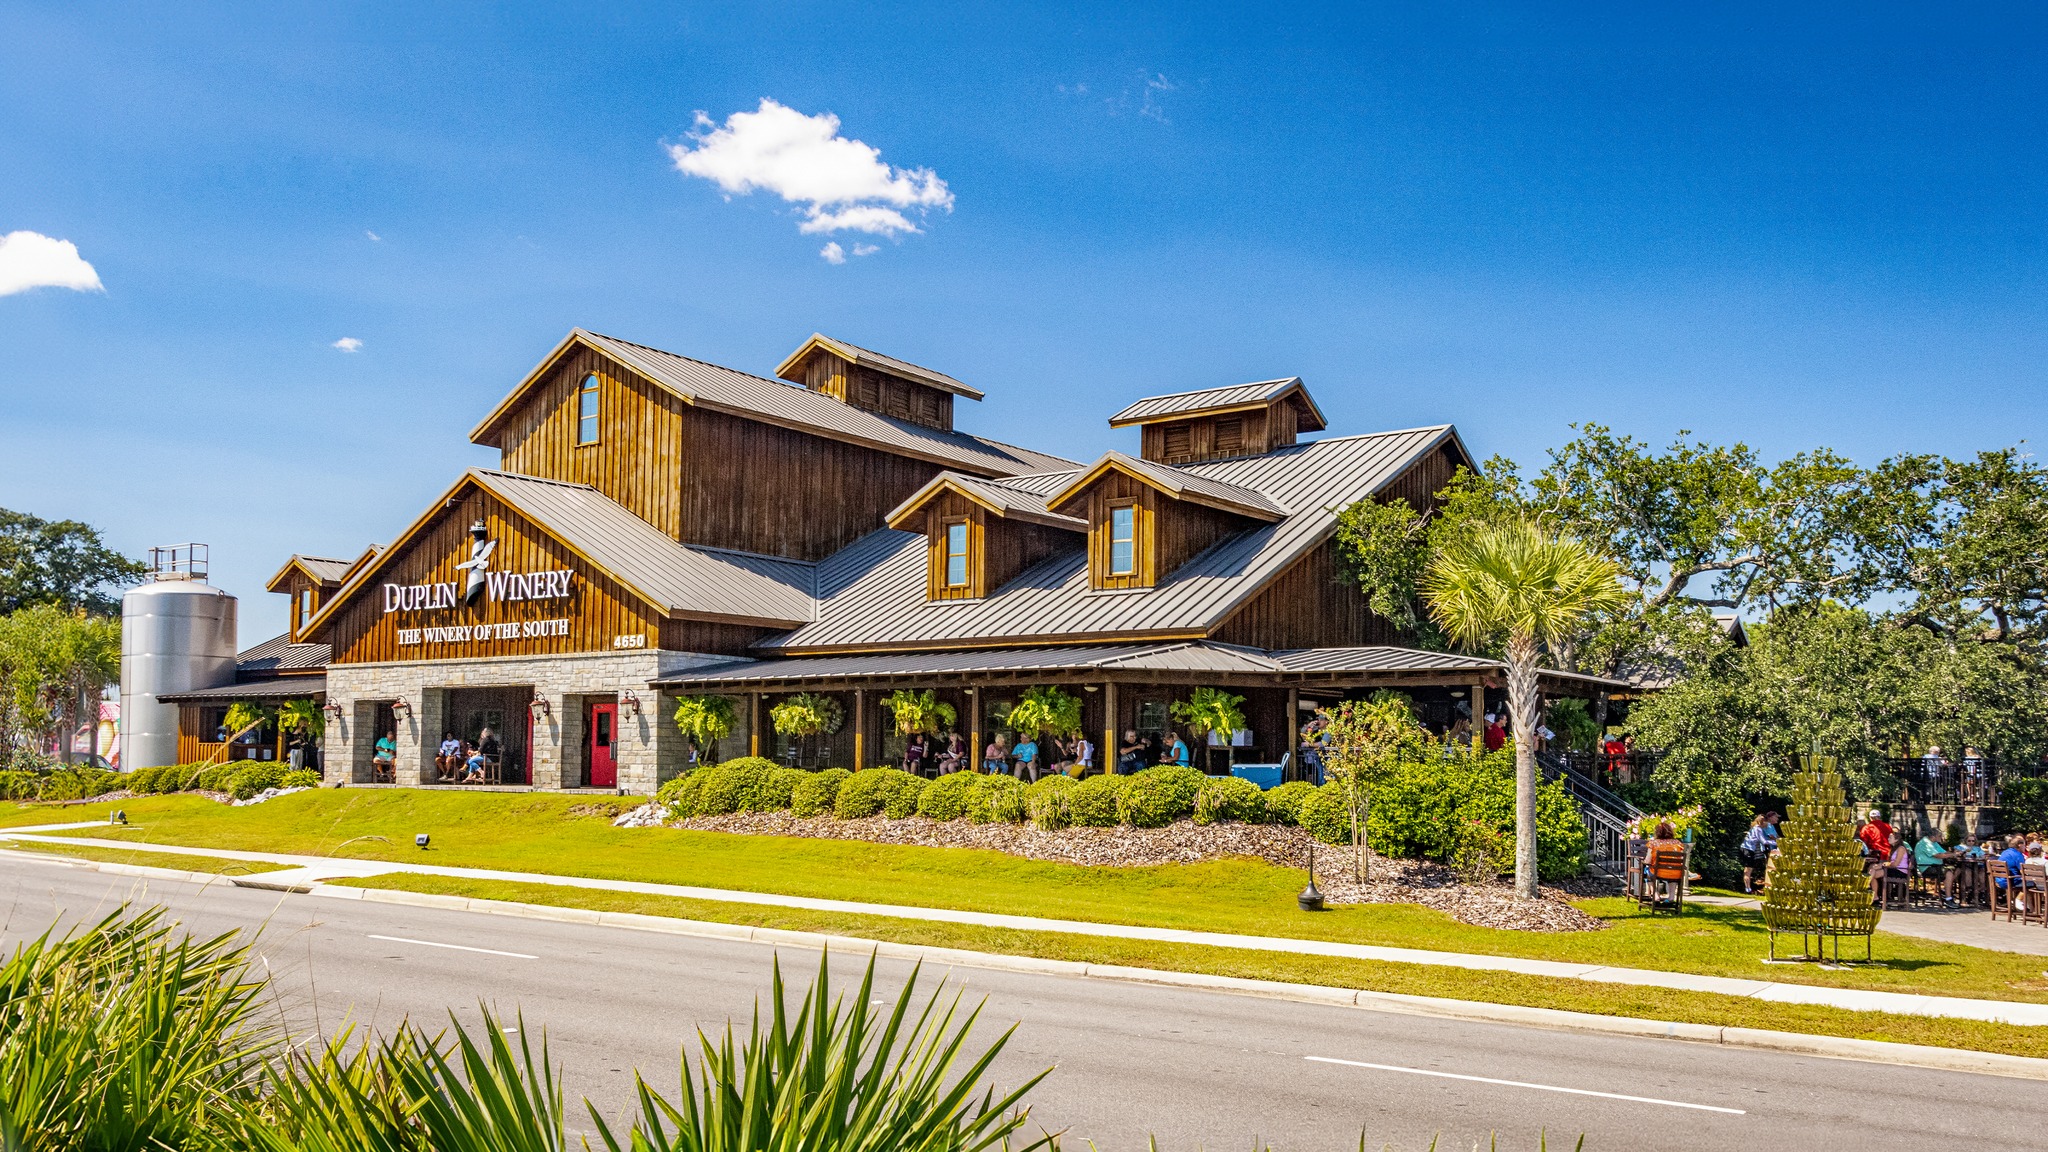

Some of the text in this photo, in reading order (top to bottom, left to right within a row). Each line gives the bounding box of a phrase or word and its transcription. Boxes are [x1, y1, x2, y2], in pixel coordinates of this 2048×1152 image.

[384, 570, 574, 613] DUPLIN WINERY
[398, 618, 569, 644] THE WINERY OF THE SOUTH
[613, 634, 645, 649] 4650
